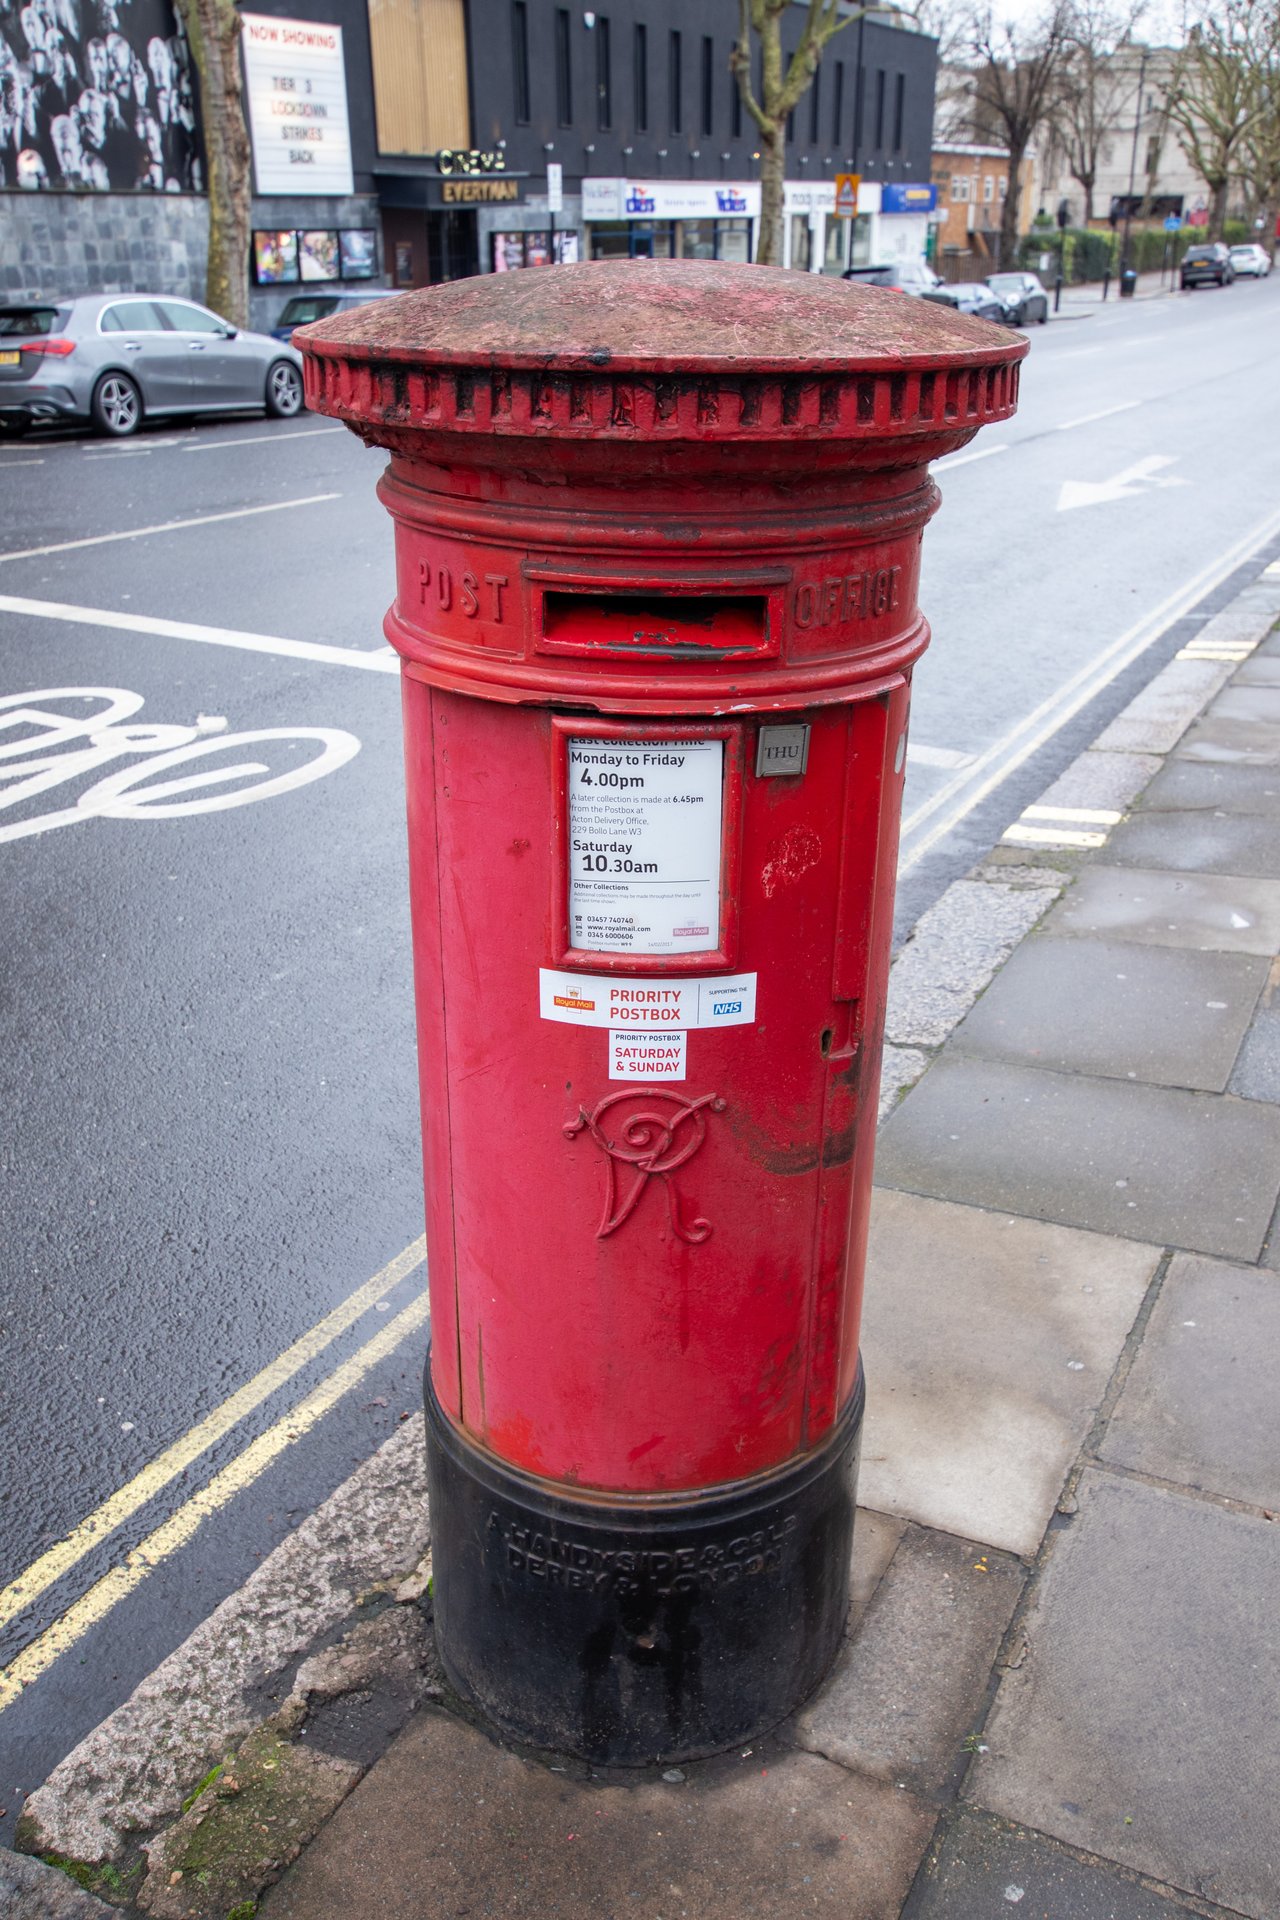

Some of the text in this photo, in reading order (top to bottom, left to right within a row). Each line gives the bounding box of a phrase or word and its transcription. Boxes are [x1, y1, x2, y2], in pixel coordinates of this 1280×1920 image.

[250, 26, 336, 49] NOW SHOWING
[272, 76, 297, 92] TIER
[271, 101, 328, 118] LOCKDOWN
[281, 126, 323, 141] STRIKES
[289, 150, 316, 165] BACK
[442, 180, 519, 202] EVERYMAN
[418, 556, 508, 624] POST
[571, 751, 686, 767] Monday to Friday
[764, 745, 801, 760] THU
[580, 768, 645, 790] 4.00pm
[578, 793, 595, 802] later
[596, 794, 630, 804] collection
[632, 795, 639, 804] is
[641, 795, 662, 804] made
[663, 796, 672, 804] at
[672, 795, 704, 804] 6.45pm
[571, 805, 644, 815] from the Postbox at
[572, 815, 593, 824] Acton
[594, 815, 624, 826] Delivery
[572, 826, 642, 836] 229 Bollo Lane W3
[573, 840, 633, 855] Saturday
[582, 854, 658, 873] 10.30am
[574, 882, 629, 891] Other Collections
[587, 915, 634, 924] 03457 740740
[587, 924, 651, 933] www.royalmail.com
[587, 931, 604, 939] 0345
[610, 989, 682, 1003] PRIORITY
[708, 988, 737, 996] SUPPORTING
[555, 997, 593, 1010] Royal Mail
[714, 1001, 741, 1015] NHS
[610, 1007, 681, 1021] POSTBOX
[649, 1034, 681, 1042] POSTBOX
[615, 1047, 681, 1059] SATURDAY
[616, 1061, 680, 1072] & SUNDAY
